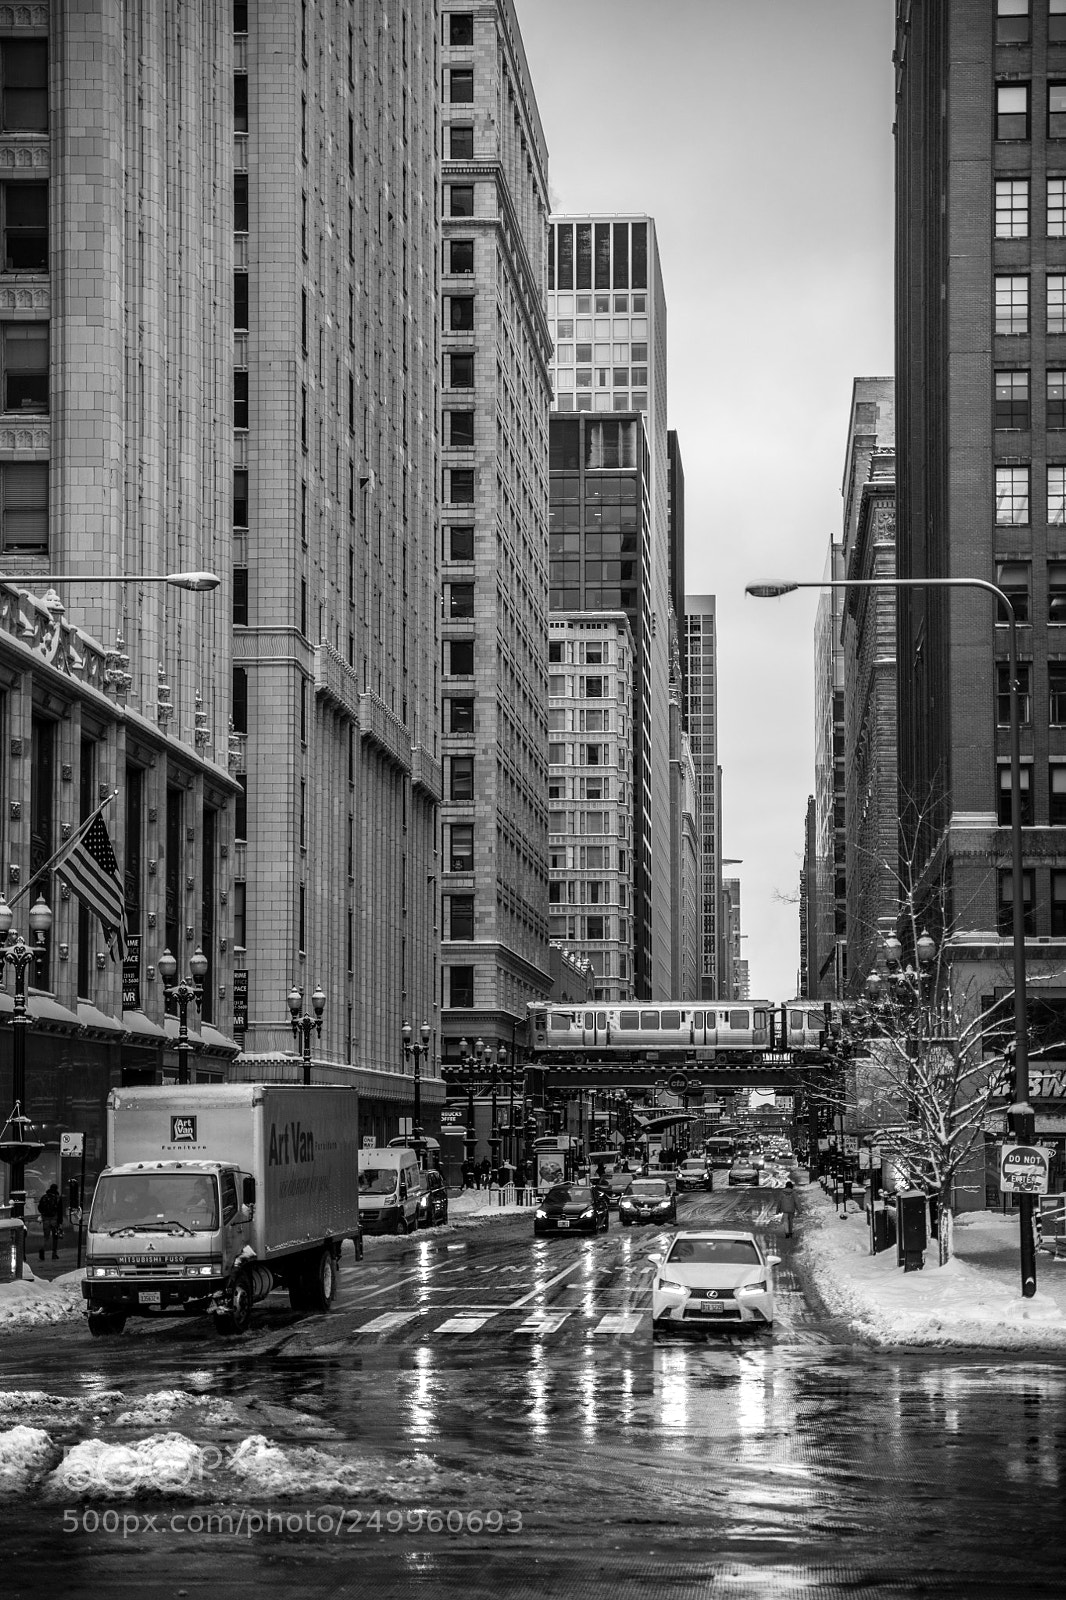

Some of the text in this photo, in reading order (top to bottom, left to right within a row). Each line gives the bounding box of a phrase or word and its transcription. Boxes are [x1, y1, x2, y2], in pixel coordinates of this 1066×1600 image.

[123, 954, 139, 963] PACE
[671, 1079, 686, 1088] cta
[177, 1119, 192, 1127] Art
[177, 1126, 193, 1134] Van
[268, 1123, 290, 1166] Art
[290, 1121, 314, 1163] Van
[1008, 1154, 1042, 1164] DO NOT
